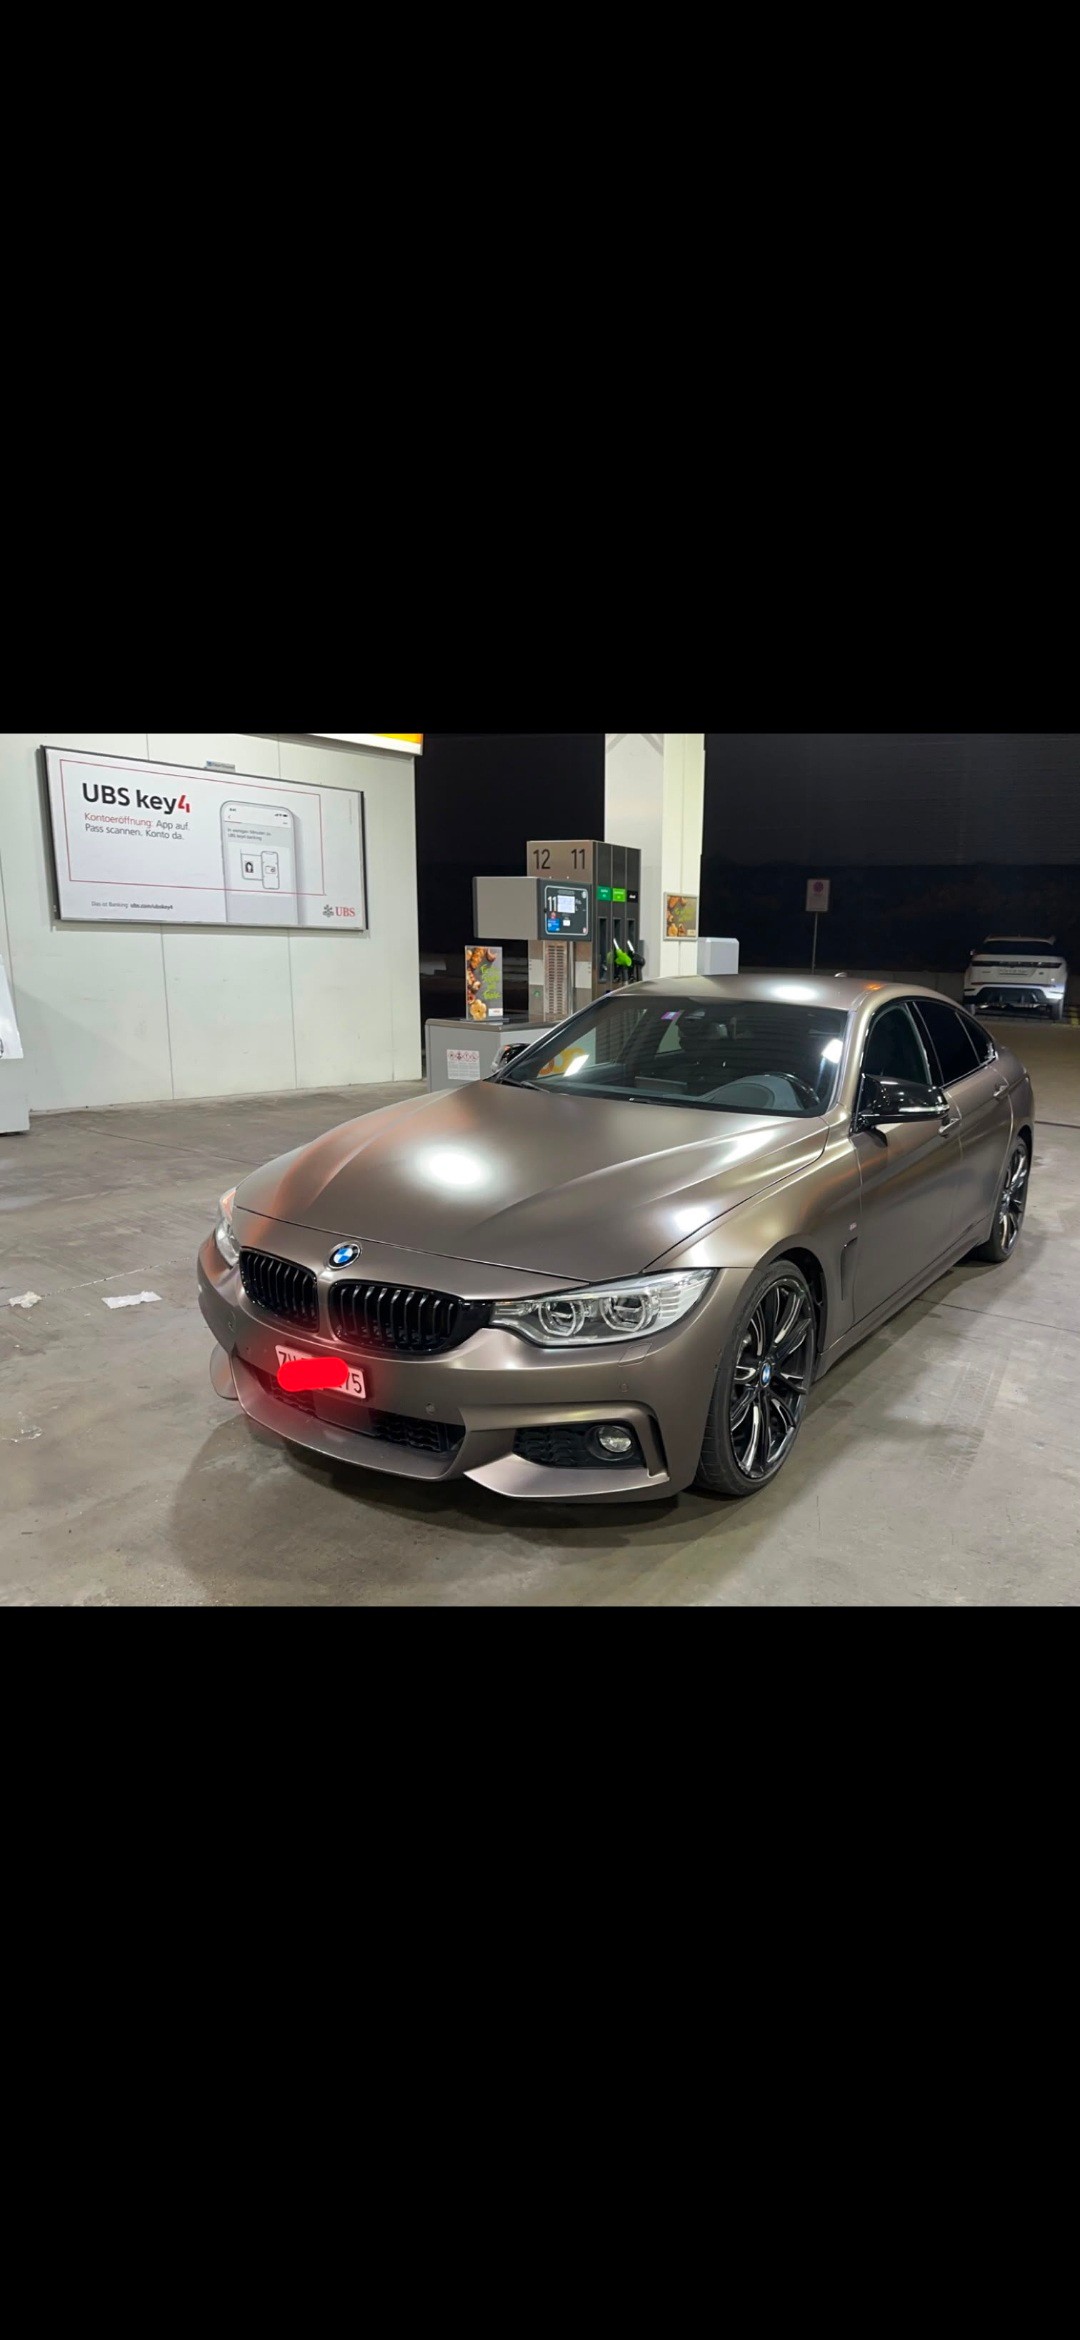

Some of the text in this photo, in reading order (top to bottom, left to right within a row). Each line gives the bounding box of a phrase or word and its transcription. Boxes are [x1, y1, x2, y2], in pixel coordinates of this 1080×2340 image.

[82, 782, 191, 815] UBS key4
[85, 822, 185, 840] Pass scannen. Konto da.
[156, 820, 174, 831] App
[533, 848, 551, 870] 12
[571, 848, 586, 870] 11
[335, 906, 356, 917] UBS
[547, 896, 557, 912] 11
